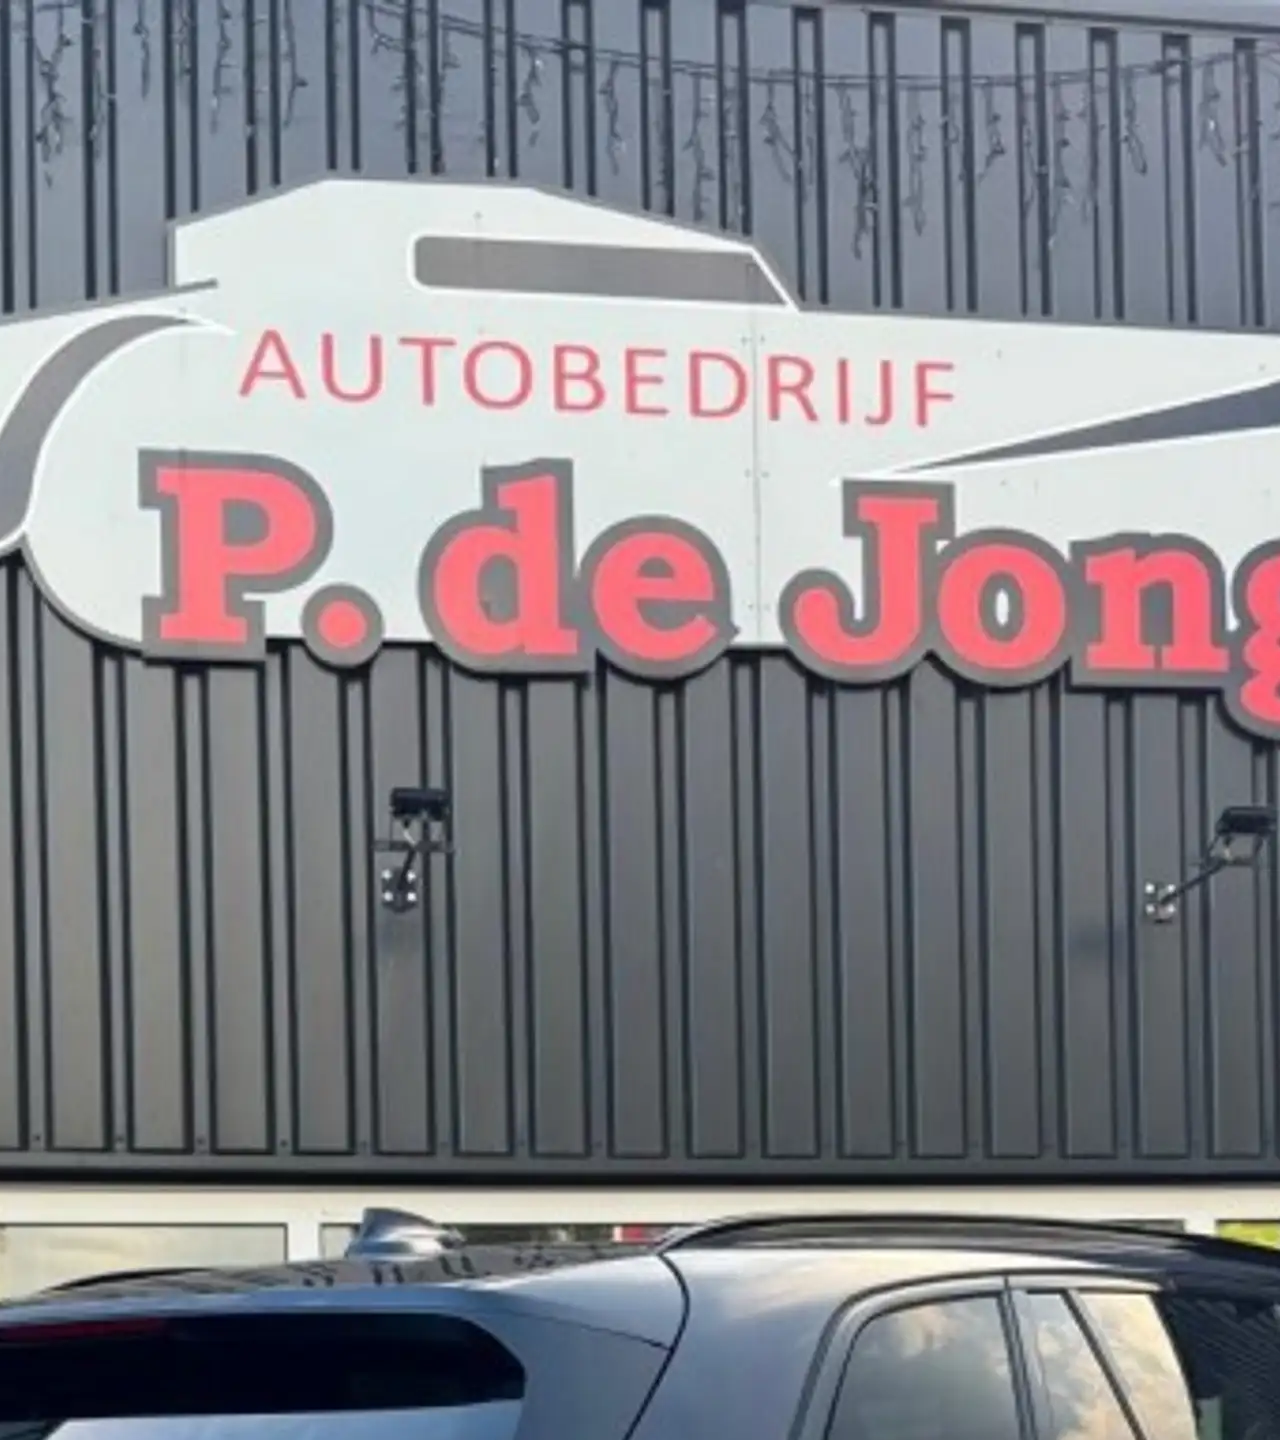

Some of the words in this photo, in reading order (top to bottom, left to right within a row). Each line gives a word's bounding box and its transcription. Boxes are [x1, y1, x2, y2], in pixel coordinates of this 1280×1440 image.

[238, 328, 956, 428] AUTOBEDRIJF
[153, 464, 370, 651] P.
[431, 472, 720, 664] de
